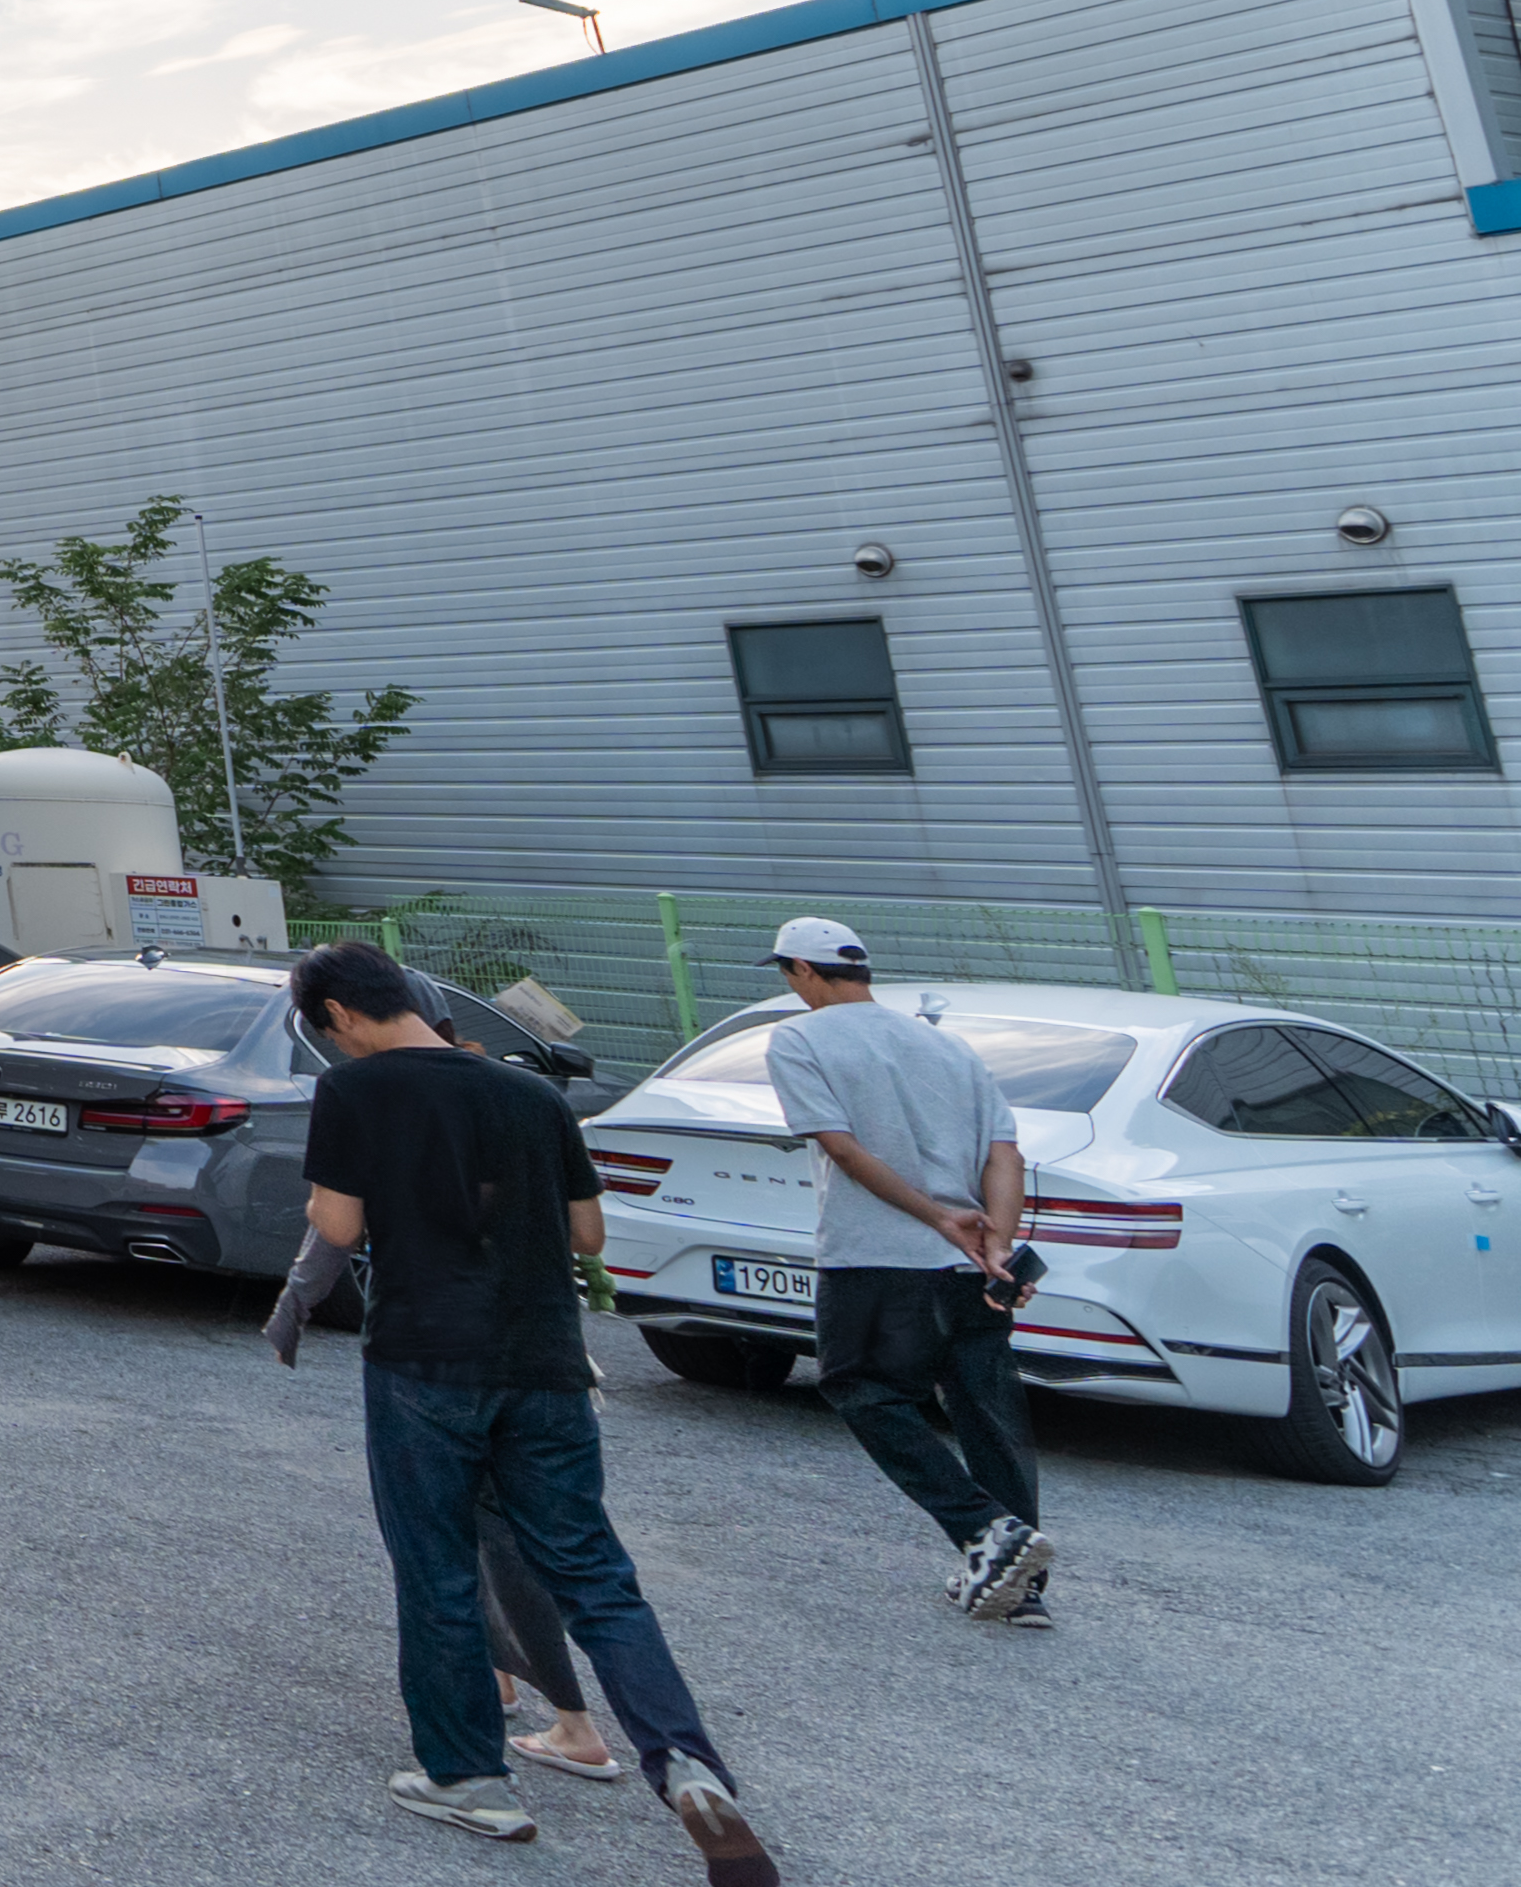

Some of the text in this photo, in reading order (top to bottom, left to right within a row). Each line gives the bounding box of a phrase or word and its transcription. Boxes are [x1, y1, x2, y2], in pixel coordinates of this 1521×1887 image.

[132, 878, 193, 894] 긴급연락처
[14, 1102, 61, 1127] 2616
[661, 1195, 696, 1206] G80
